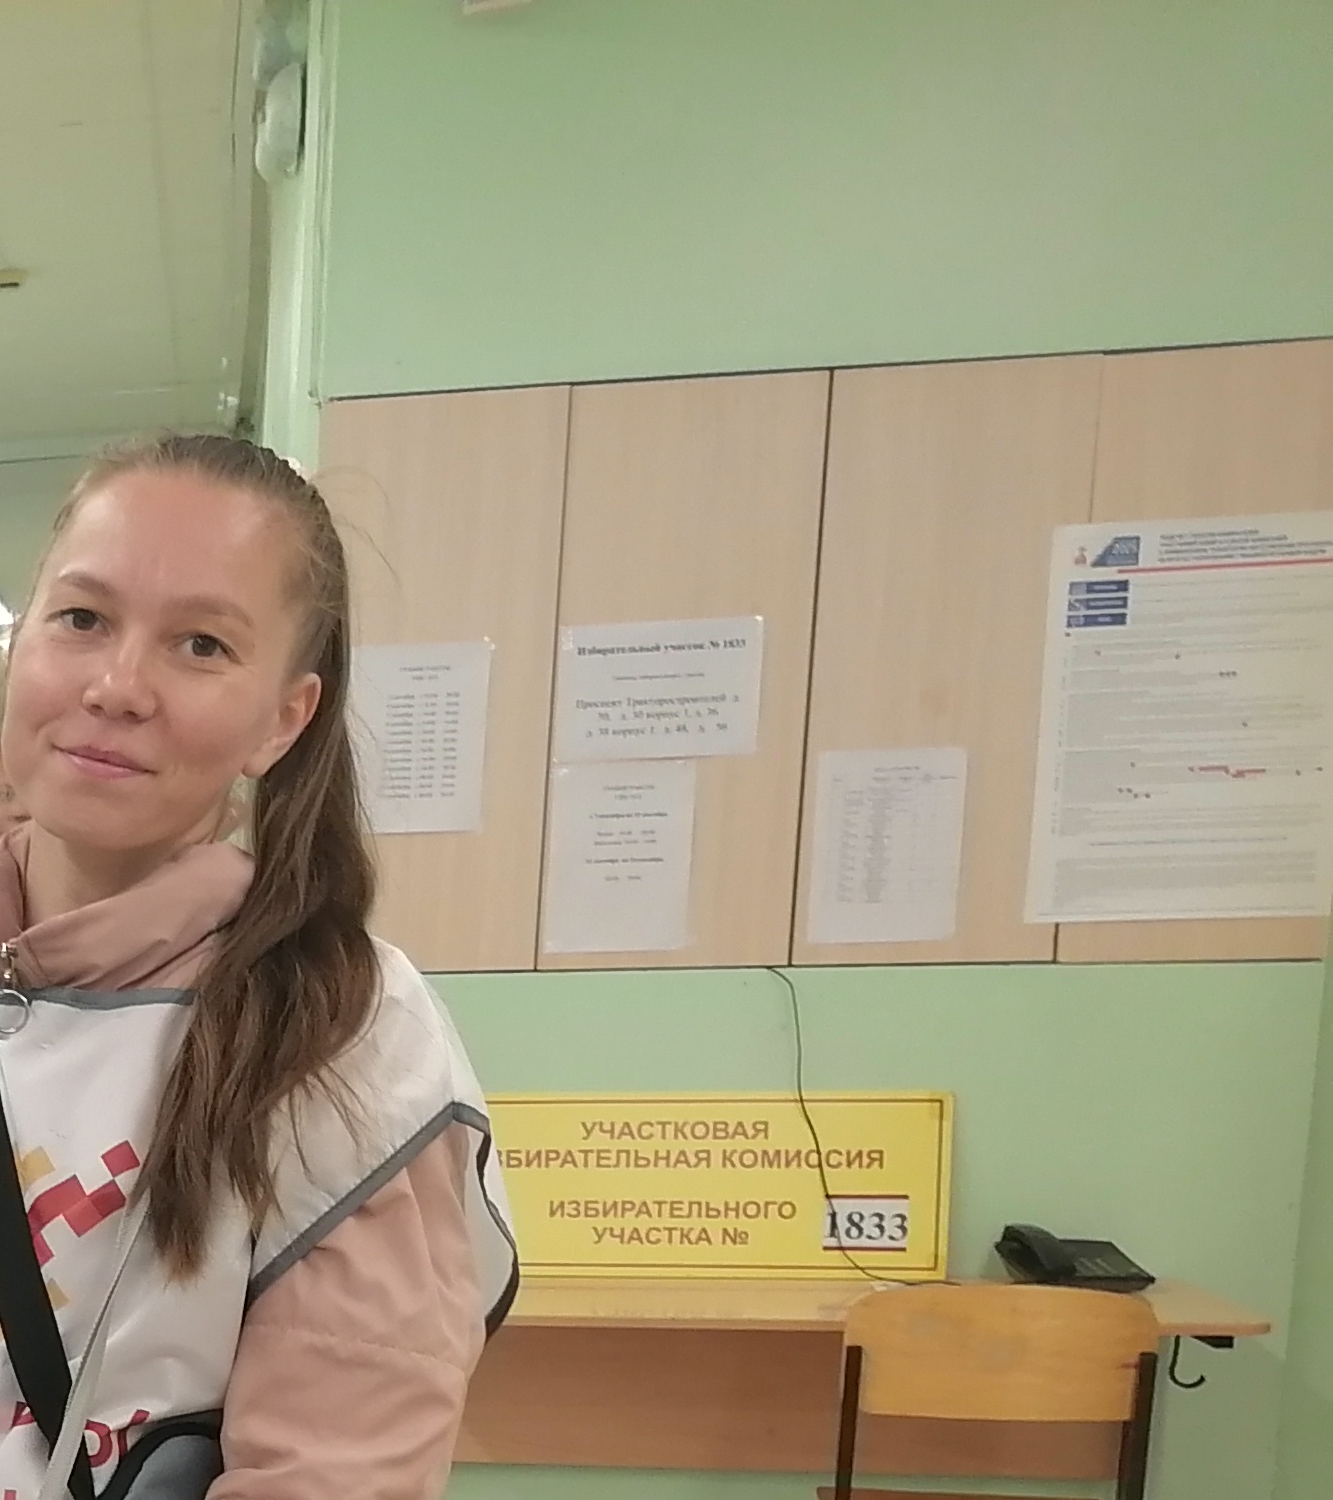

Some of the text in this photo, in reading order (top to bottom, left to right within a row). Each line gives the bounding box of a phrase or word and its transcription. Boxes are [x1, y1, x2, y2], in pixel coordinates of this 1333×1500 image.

[580, 1119, 771, 1142] УЧАСТКОВАЯ
[496, 1147, 886, 1170] БИРАТЕЛЬНАЯ КОМИССИЯ
[547, 1199, 798, 1221] ИЗБИРАТЕЛЬНОГО
[591, 1209, 910, 1247] УЧАСТКА № 1833
